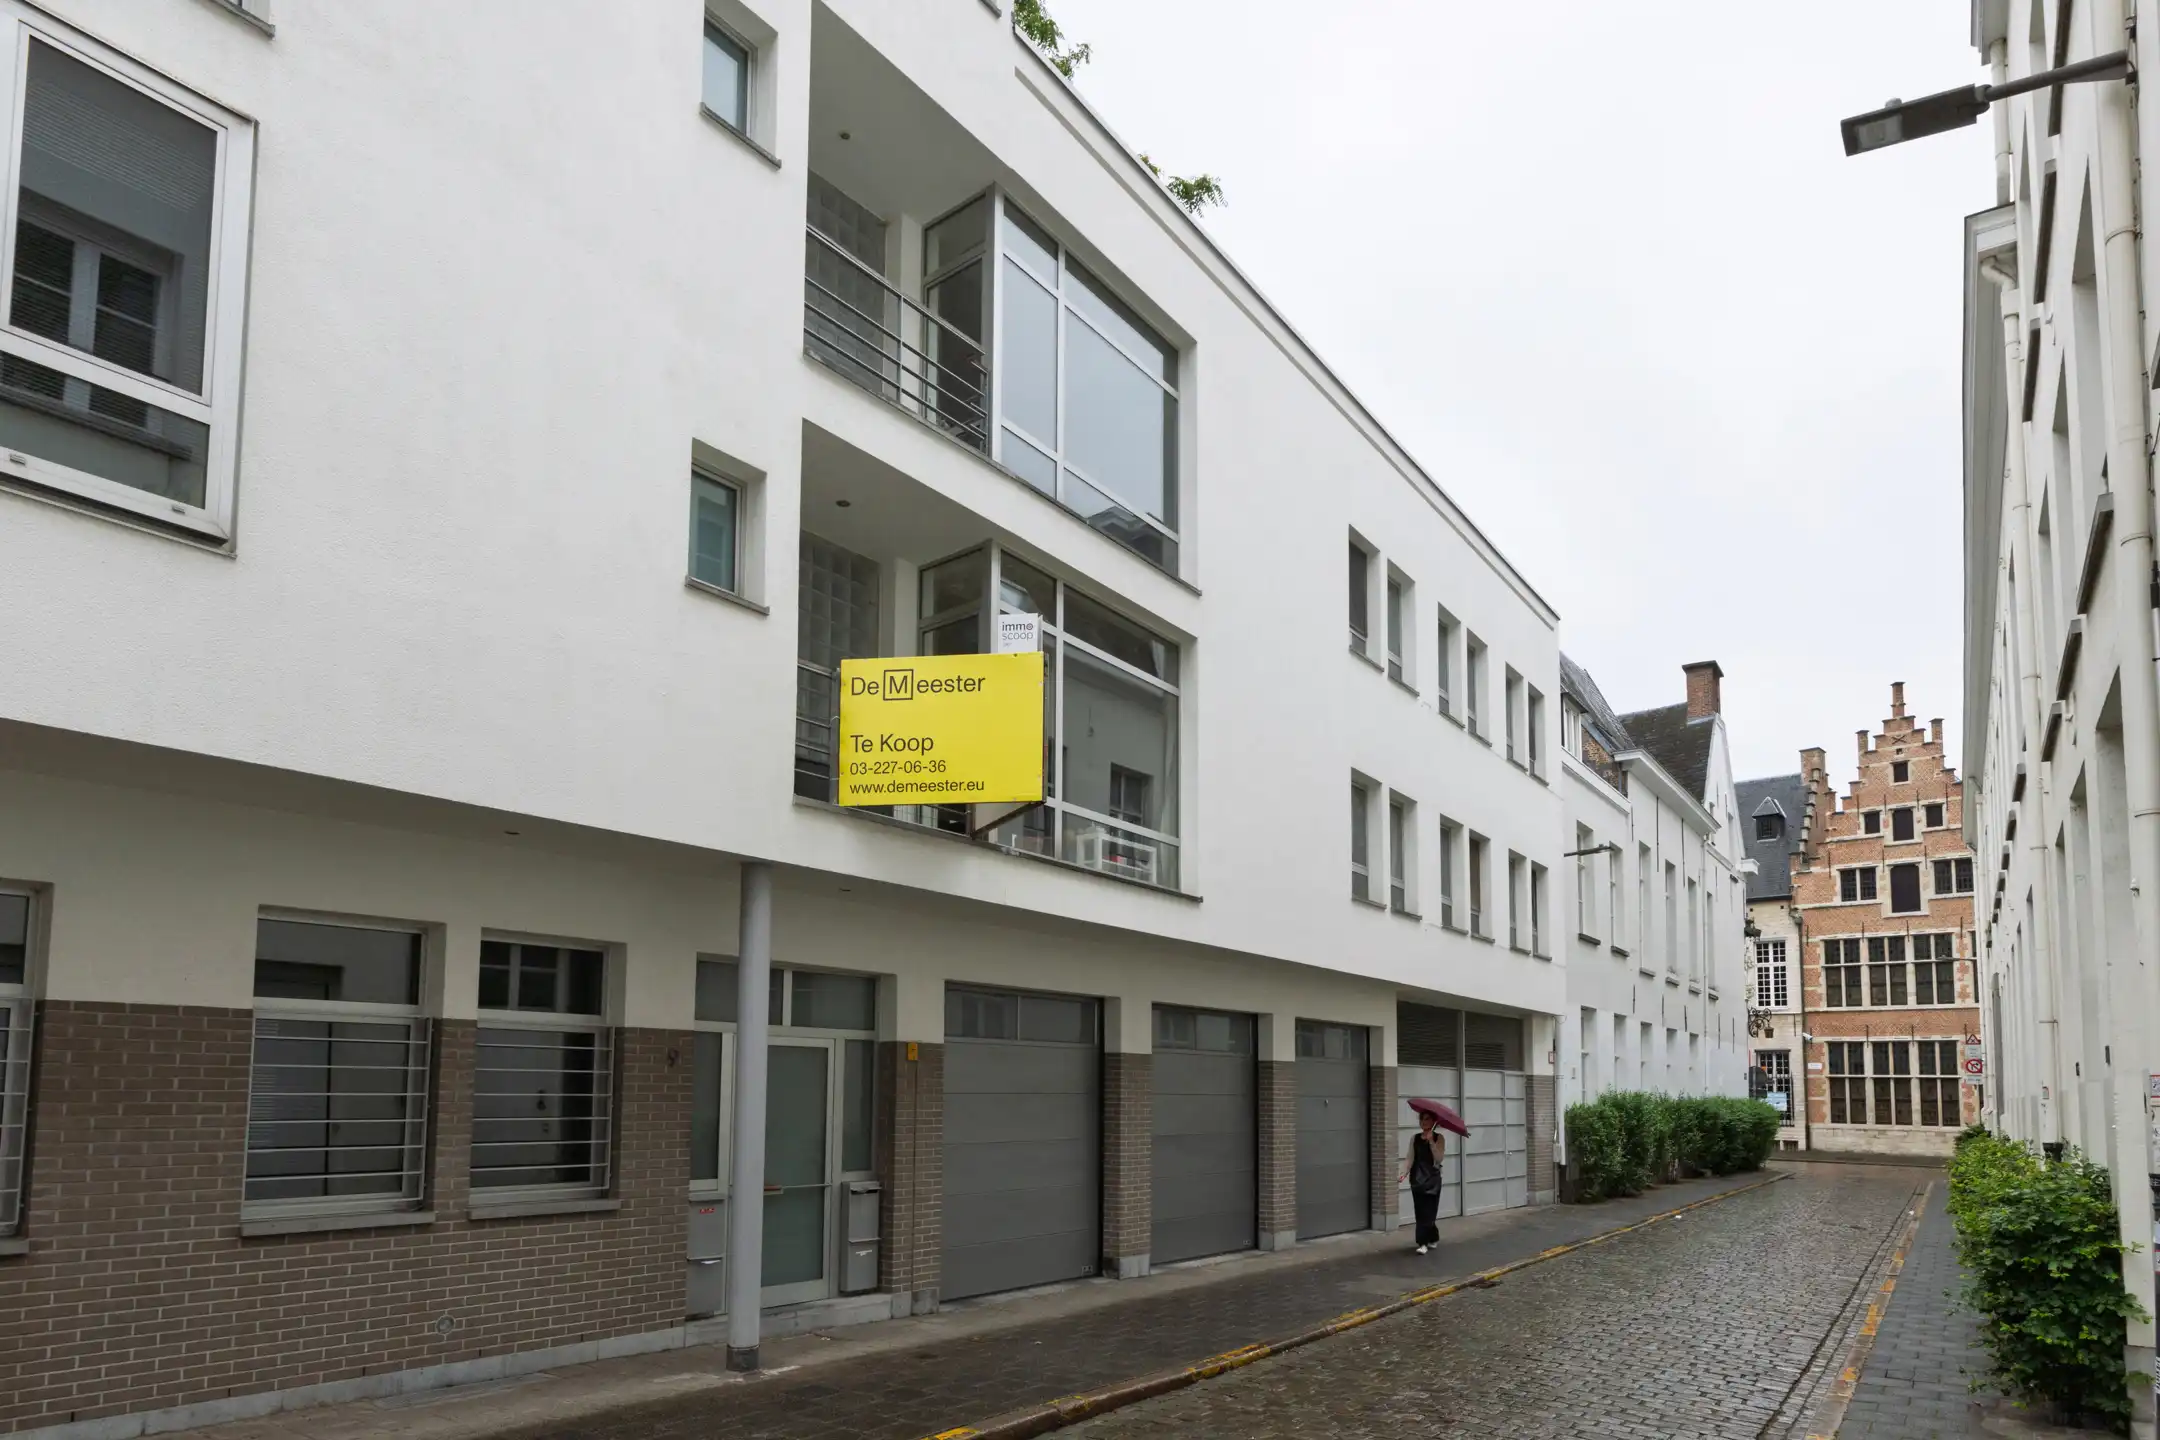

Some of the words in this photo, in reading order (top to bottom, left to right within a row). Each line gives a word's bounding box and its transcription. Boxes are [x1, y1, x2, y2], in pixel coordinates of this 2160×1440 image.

[1002, 621, 1034, 632] immo
[850, 734, 873, 753] Te
[880, 733, 934, 756] Koop
[849, 760, 947, 775] 03-227-06-36
[849, 780, 985, 794] www.demeester.eu
